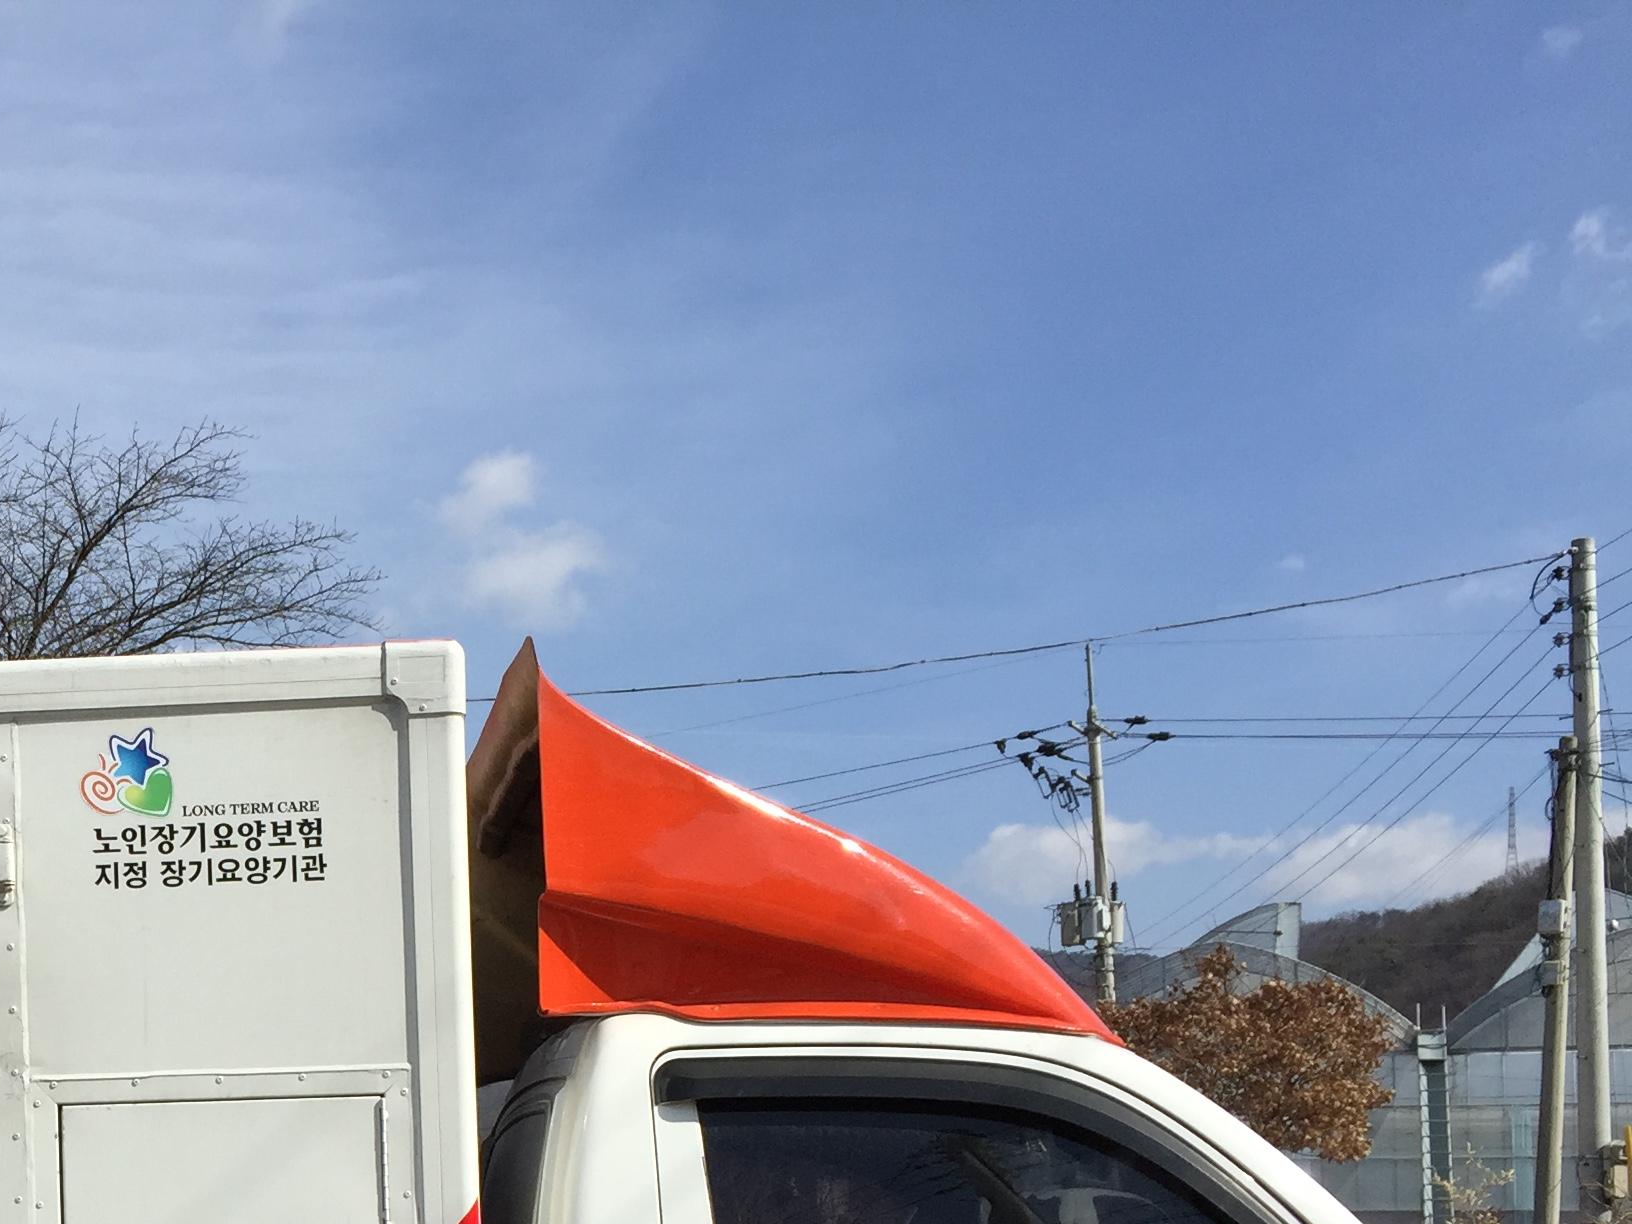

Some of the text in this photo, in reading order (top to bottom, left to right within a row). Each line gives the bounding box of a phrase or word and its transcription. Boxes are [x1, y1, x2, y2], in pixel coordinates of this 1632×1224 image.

[182, 800, 320, 817] LONG TERM CARE
[92, 818, 324, 856] 노인장기요양보험
[94, 853, 328, 890] 지정 장기요양기관
